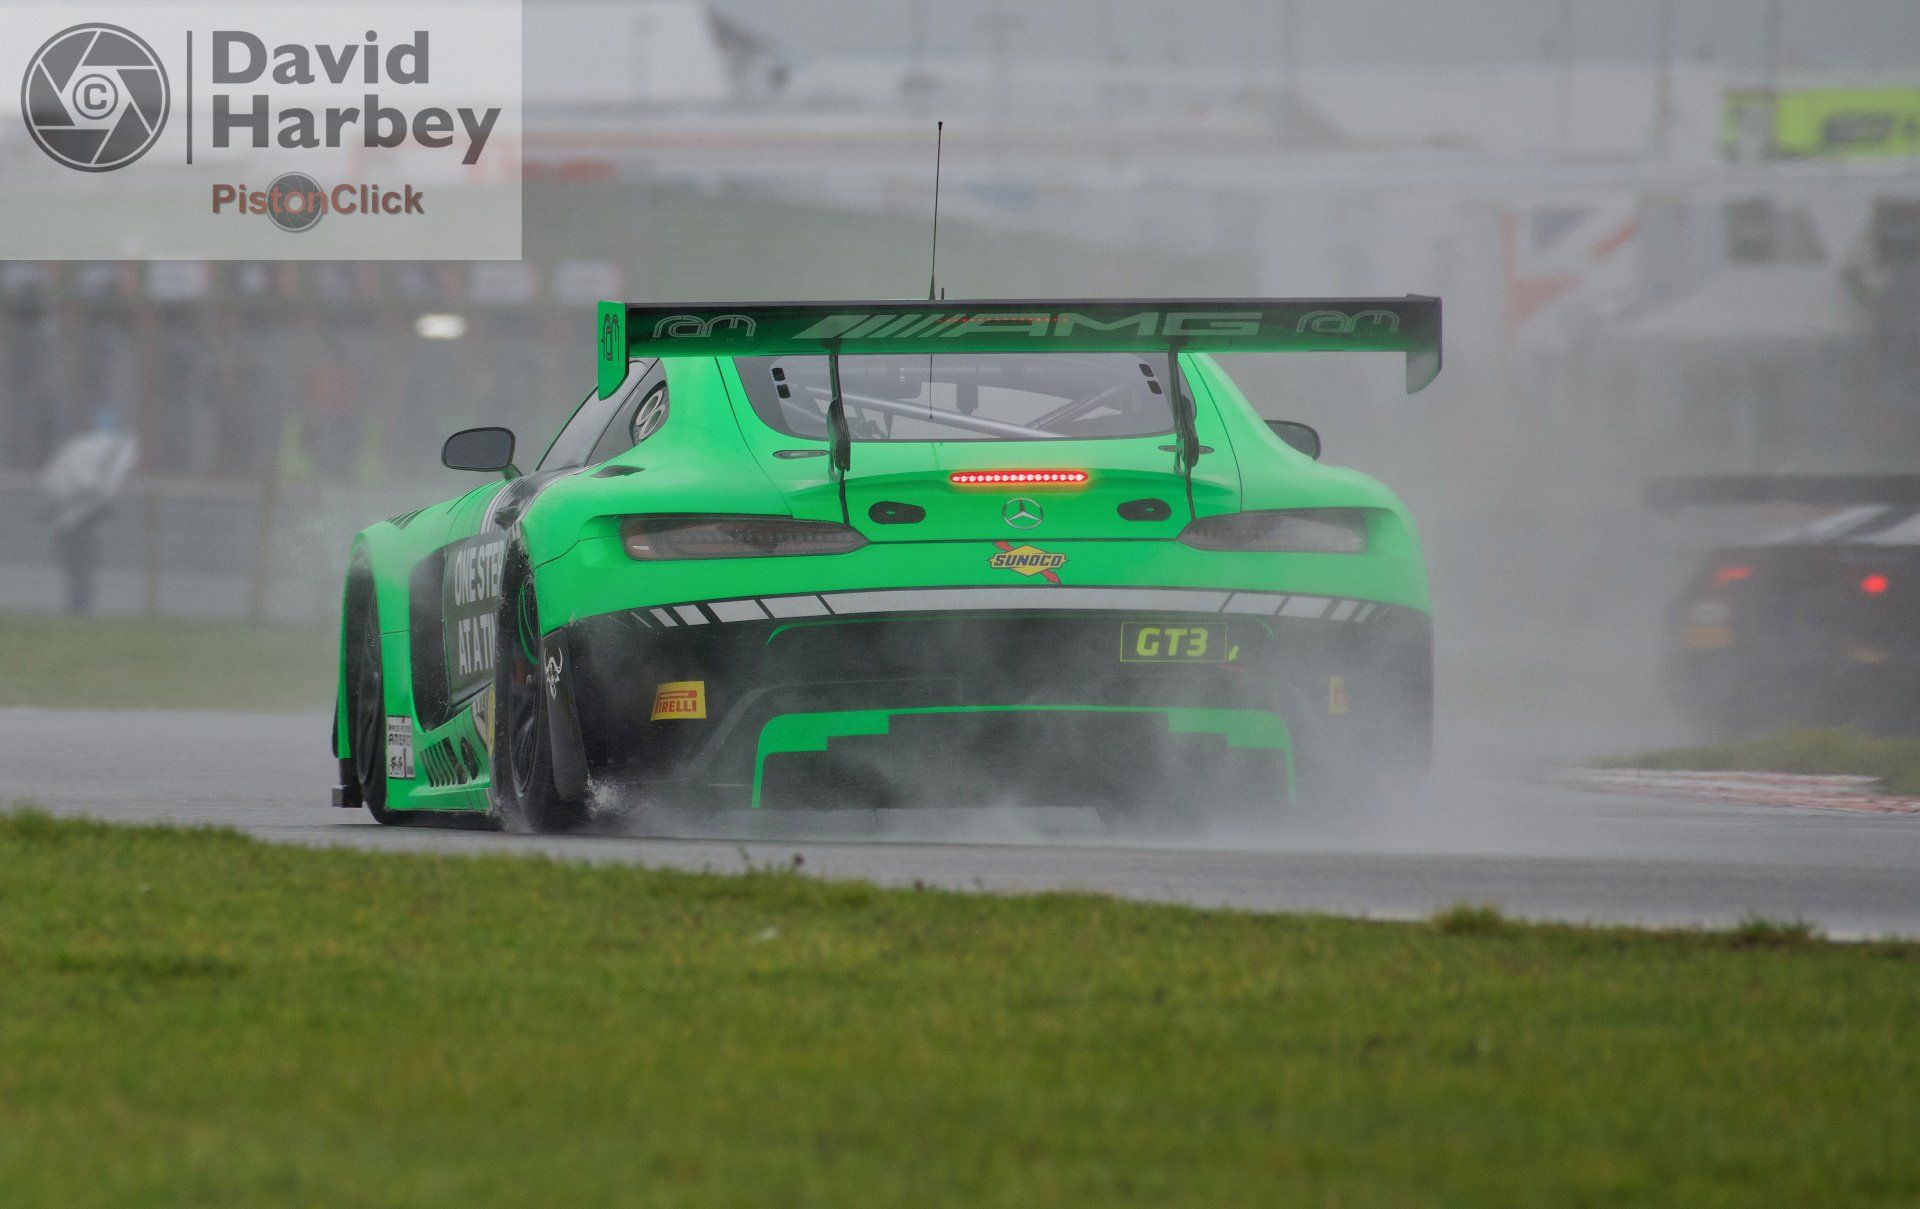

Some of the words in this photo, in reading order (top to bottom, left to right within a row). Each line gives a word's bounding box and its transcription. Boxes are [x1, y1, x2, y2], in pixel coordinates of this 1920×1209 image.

[941, 312, 1263, 338] AMG
[454, 547, 478, 607] ONE
[477, 540, 505, 601] STEP
[993, 554, 1063, 567] SUNOCO
[458, 618, 472, 676] AT
[473, 616, 484, 672] A
[1136, 627, 1209, 657] GT3
[654, 689, 698, 714] PIRELLI
